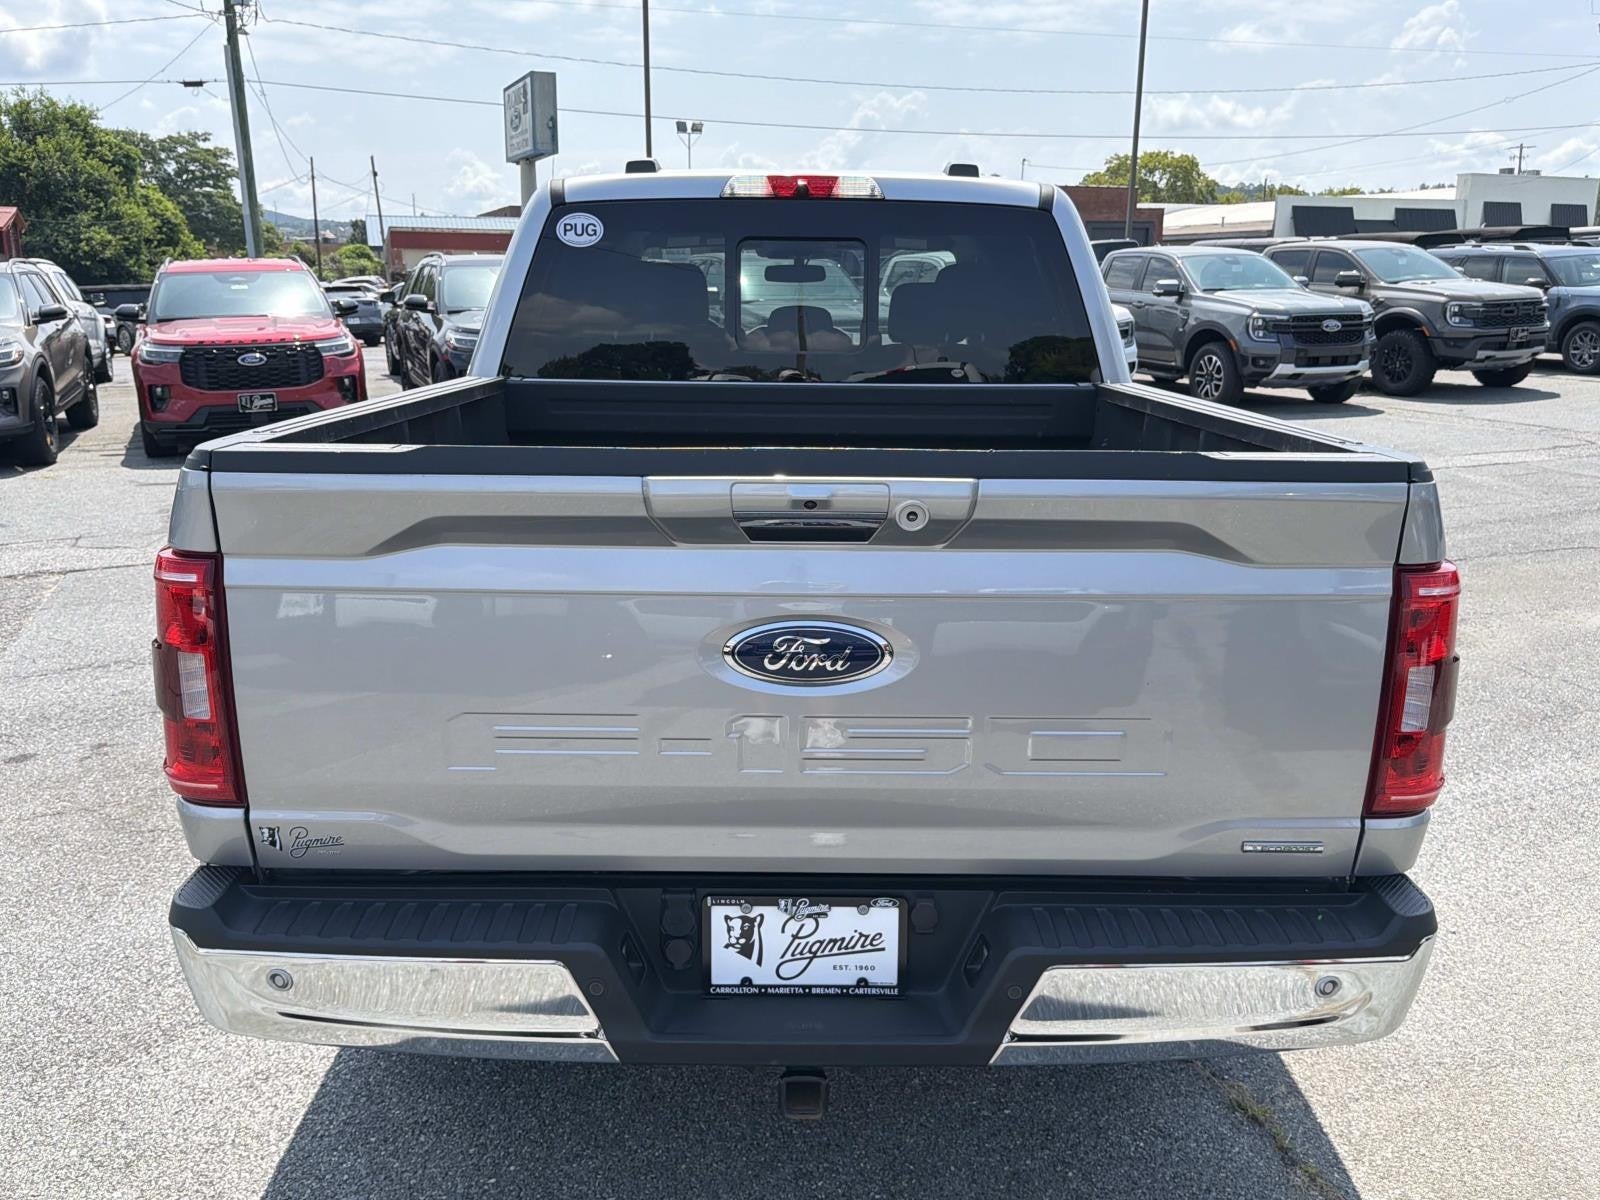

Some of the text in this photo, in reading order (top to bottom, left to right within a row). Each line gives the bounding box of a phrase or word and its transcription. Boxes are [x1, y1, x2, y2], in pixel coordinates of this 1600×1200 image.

[563, 222, 598, 237] PUG
[763, 635, 853, 671] Ford
[446, 711, 1169, 776] F-150
[289, 826, 345, 859] Pugmire
[775, 914, 886, 980] Pugmire
[710, 986, 760, 994] CARROLLTON
[848, 987, 899, 995] CARTERSVILLE
